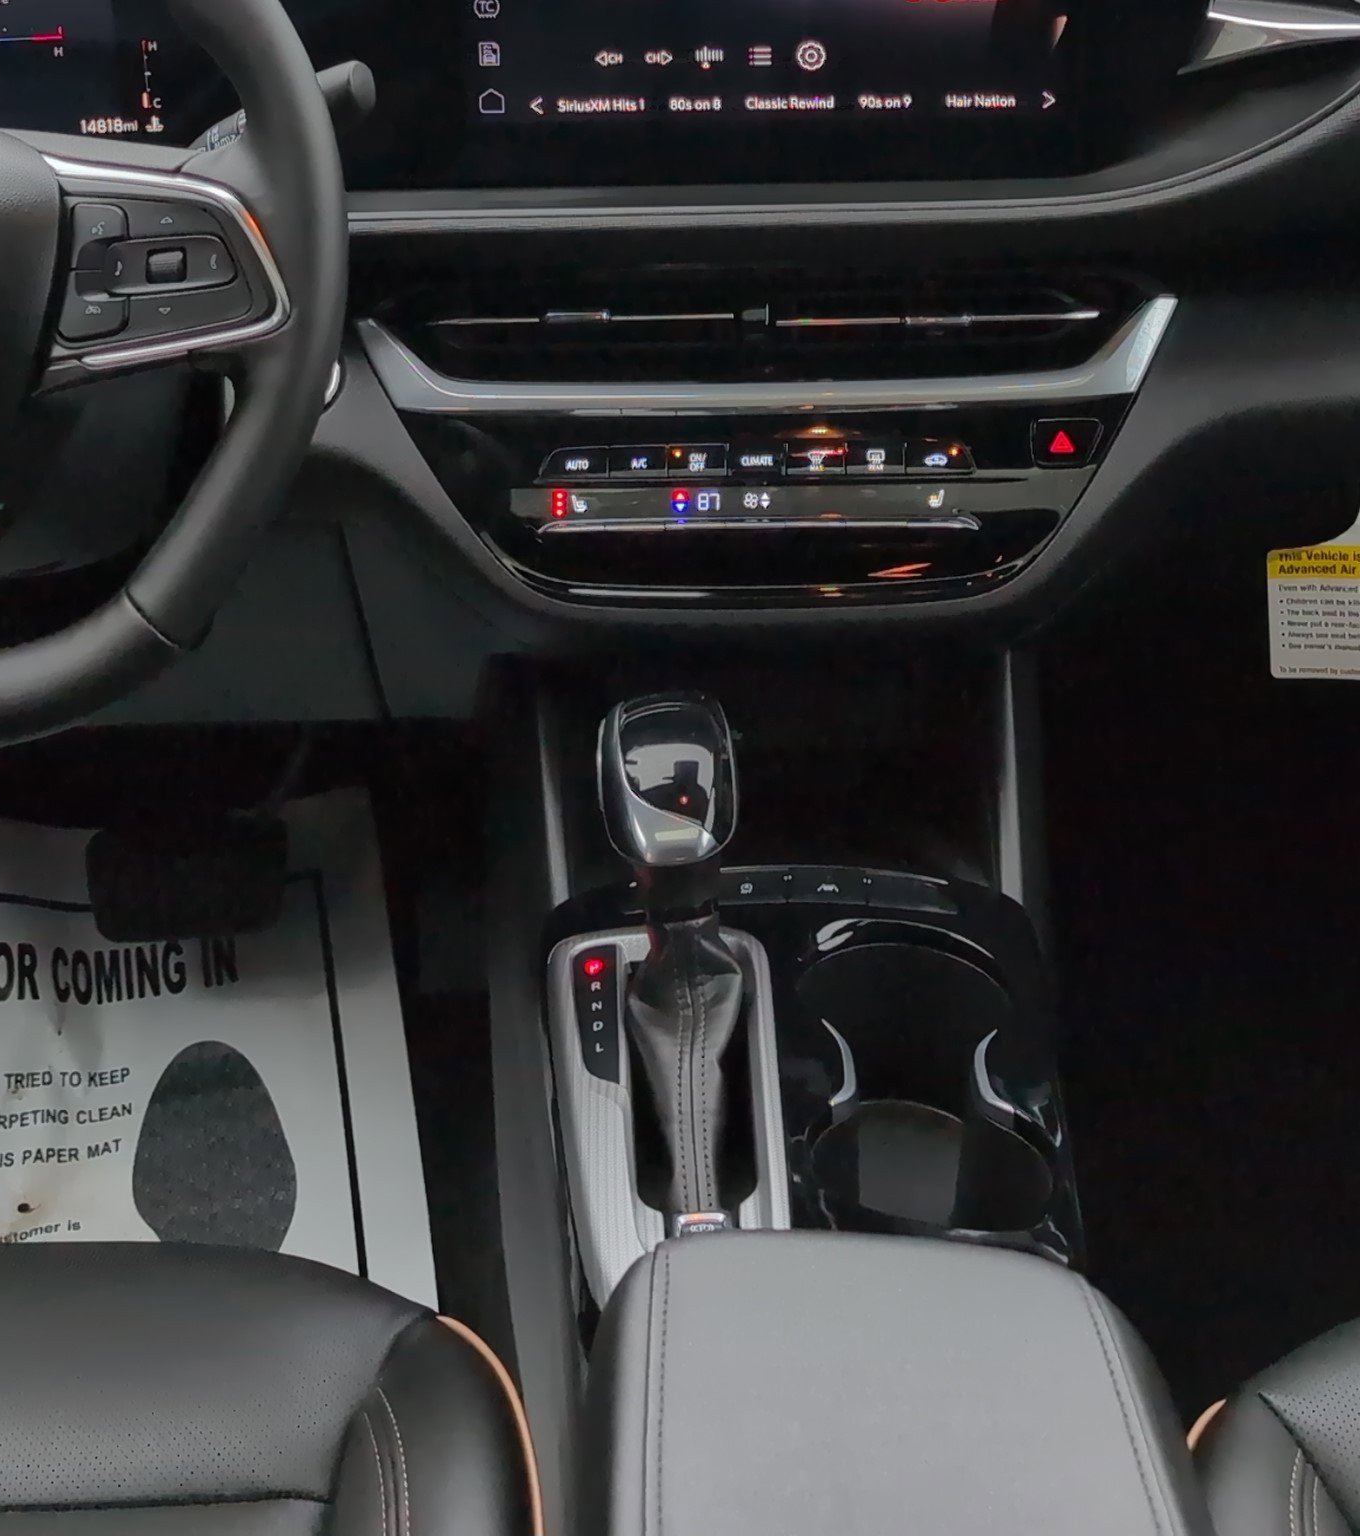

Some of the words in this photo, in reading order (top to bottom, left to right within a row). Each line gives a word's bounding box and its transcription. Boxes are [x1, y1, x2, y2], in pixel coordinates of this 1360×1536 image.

[557, 99, 611, 113] SiriusXM
[612, 99, 637, 112] Hits
[668, 98, 693, 112] 80s
[695, 100, 710, 111] on
[745, 96, 788, 110] Classic
[790, 95, 835, 110] Rewind
[858, 95, 883, 109] 90s
[885, 97, 901, 109] on
[902, 95, 913, 108] 9
[945, 94, 972, 108] Hair
[973, 94, 1016, 108] Nation
[689, 453, 708, 462] ON/
[741, 455, 774, 466] CLIMATE
[565, 459, 590, 471] AUTO
[631, 458, 648, 470] A/C
[690, 462, 706, 473] OFF
[1305, 550, 1349, 562] Vehicle
[1278, 564, 1337, 575] Advanced
[1340, 564, 1357, 575] Air
[1300, 584, 1318, 592] with
[1320, 584, 1358, 593] Advanced
[50, 939, 187, 1005] COMING
[200, 936, 240, 988] IN
[591, 981, 601, 992] R
[591, 1001, 602, 1011] N
[593, 1021, 604, 1031] D
[595, 1043, 604, 1053] L
[4, 1071, 53, 1091] TRIED
[60, 1071, 82, 1087] TO
[88, 1067, 131, 1088] KEEP
[76, 1102, 133, 1125] CLEAN
[22, 1147, 80, 1165] PAPER
[88, 1138, 122, 1159] MAT
[67, 1220, 81, 1232] is
